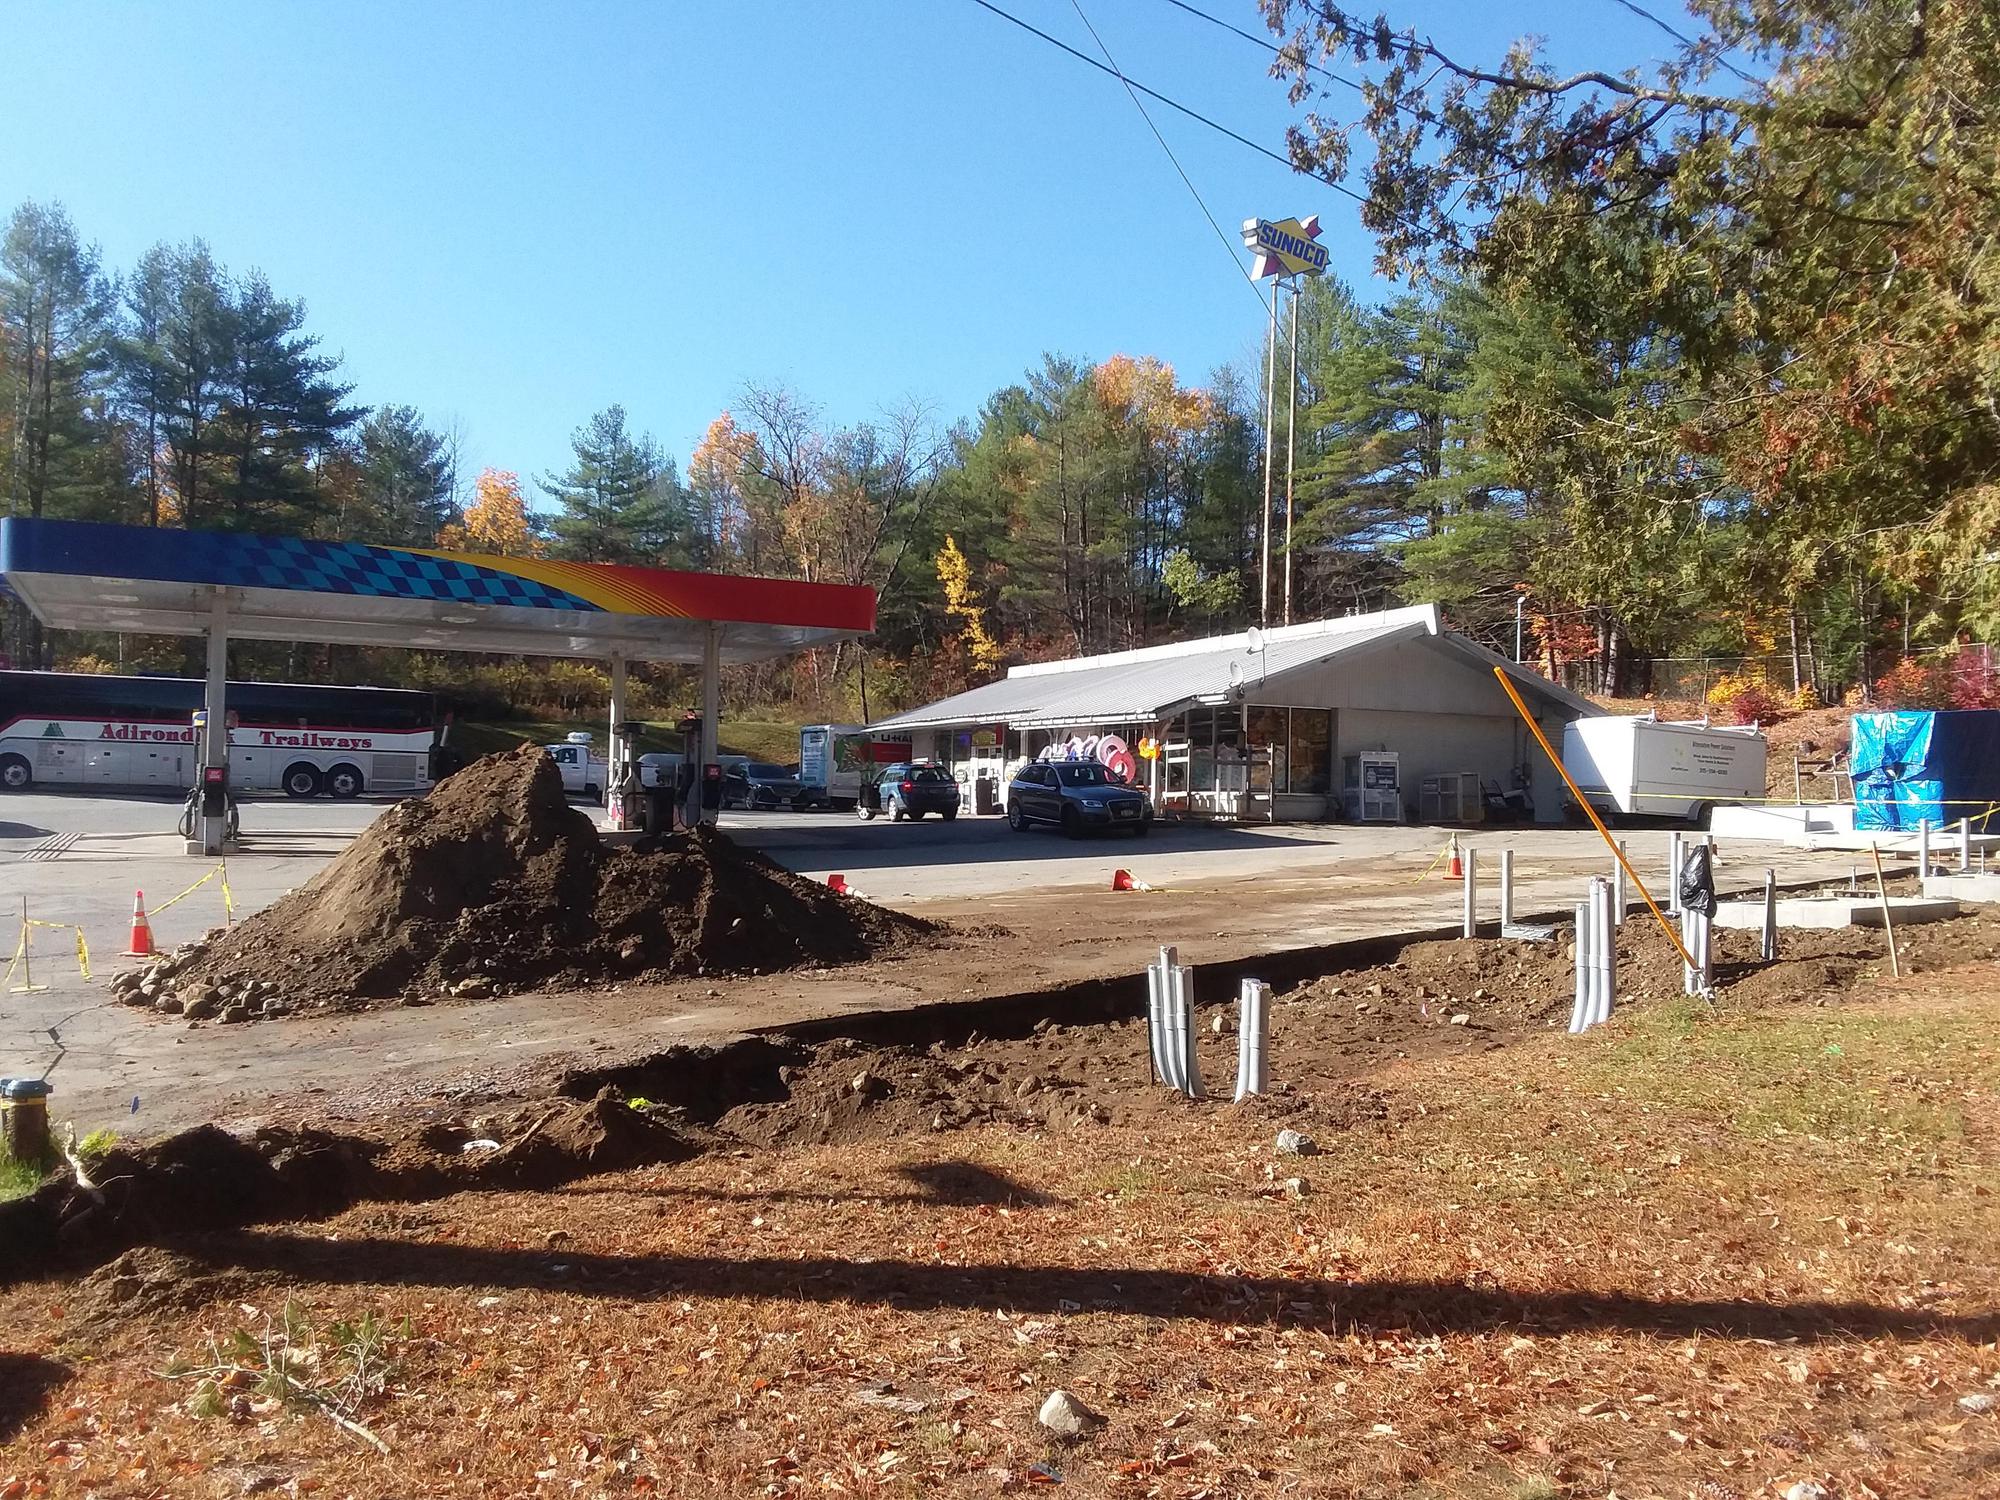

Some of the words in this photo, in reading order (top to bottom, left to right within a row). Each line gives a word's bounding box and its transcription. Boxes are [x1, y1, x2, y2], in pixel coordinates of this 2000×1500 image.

[1260, 223, 1326, 268] SUNOCO
[99, 724, 236, 743] Adirond
[259, 731, 372, 751] Trailways
